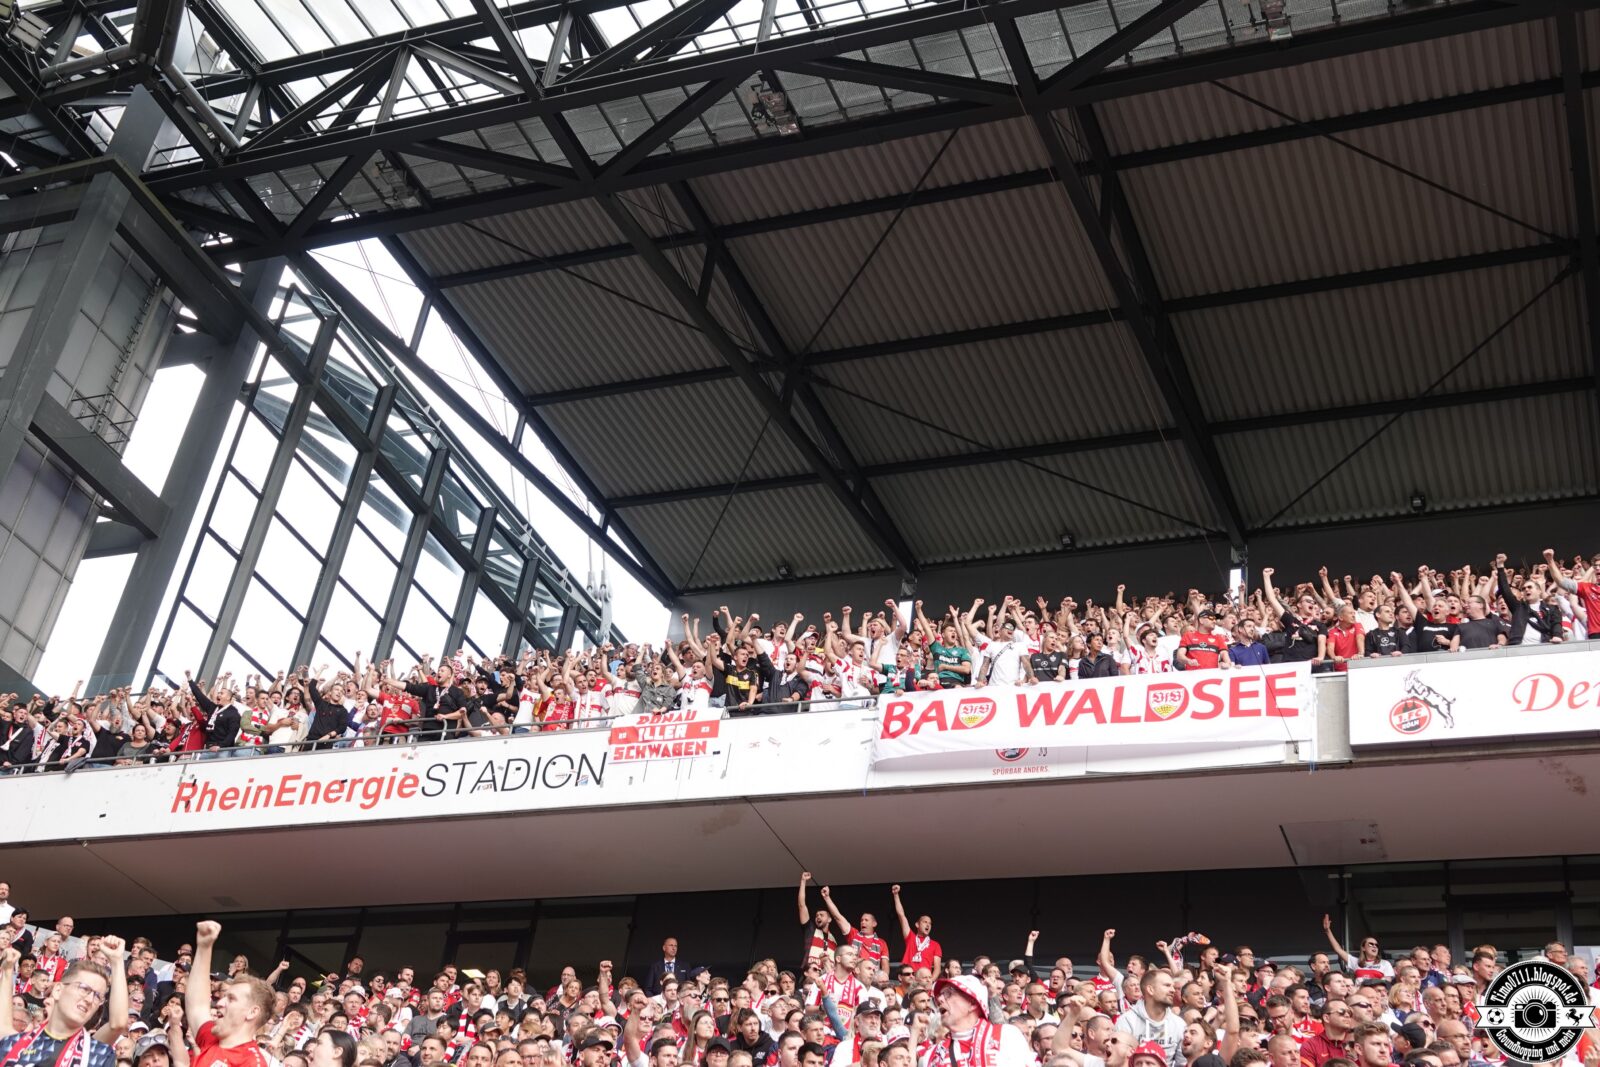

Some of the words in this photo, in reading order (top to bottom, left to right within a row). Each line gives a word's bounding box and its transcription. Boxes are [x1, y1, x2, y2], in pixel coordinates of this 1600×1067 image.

[880, 697, 997, 740] BAD
[1016, 671, 1299, 728] WALDSEE
[636, 709, 698, 725] DONAU
[638, 724, 688, 742] ILLER
[613, 740, 708, 761] SCHWABEN
